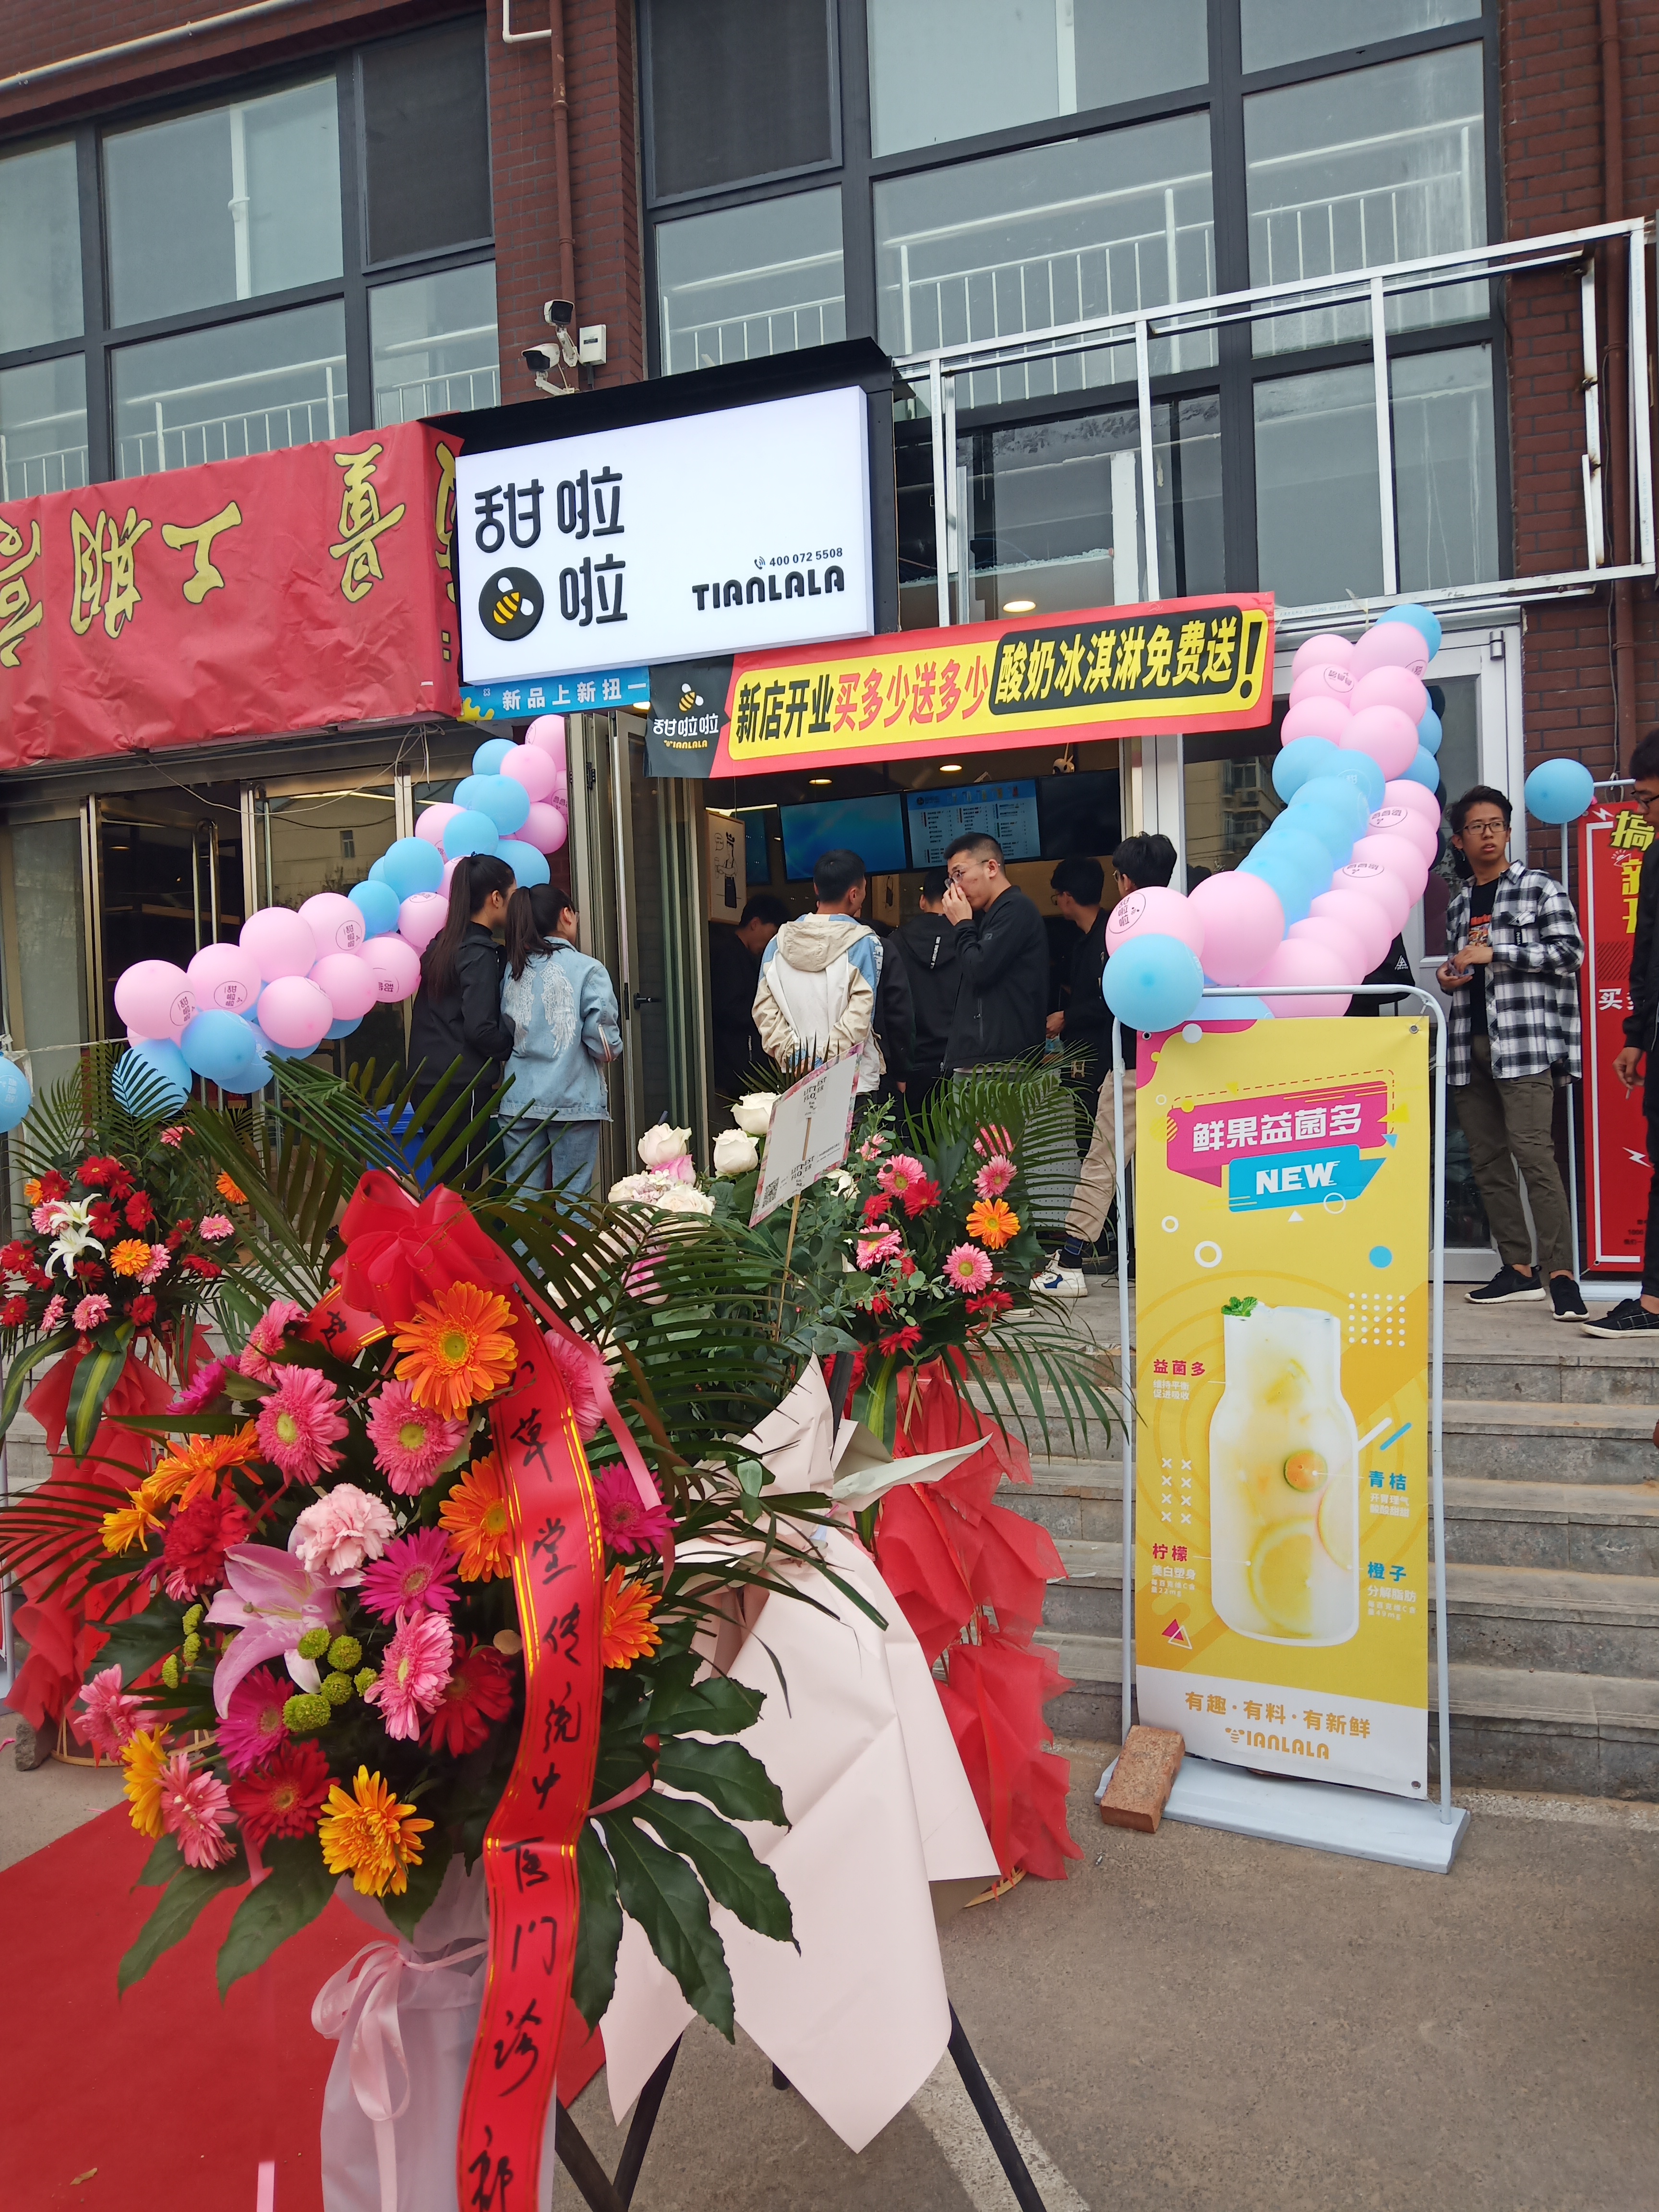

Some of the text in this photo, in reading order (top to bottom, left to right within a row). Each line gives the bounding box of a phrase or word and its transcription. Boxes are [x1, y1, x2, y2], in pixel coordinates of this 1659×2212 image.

[769, 547, 843, 567] 400 072 5508
[692, 565, 845, 611] TIANLALA
[653, 713, 719, 737] 甜啦啦
[1192, 1103, 1362, 1153] 鲜果益菌多
[1256, 1160, 1341, 1195] NEW
[1153, 1358, 1206, 1377] 益菌多
[1153, 1379, 1190, 1391] 维持平衡
[1153, 1389, 1190, 1401] 促进吸收
[1368, 1470, 1407, 1491] 青桔
[1152, 1542, 1188, 1562] 柠檬
[1151, 1564, 1196, 1580] 美白塑身
[1367, 1561, 1407, 1582] 橙子
[1367, 1585, 1417, 1603] 分解脂肪
